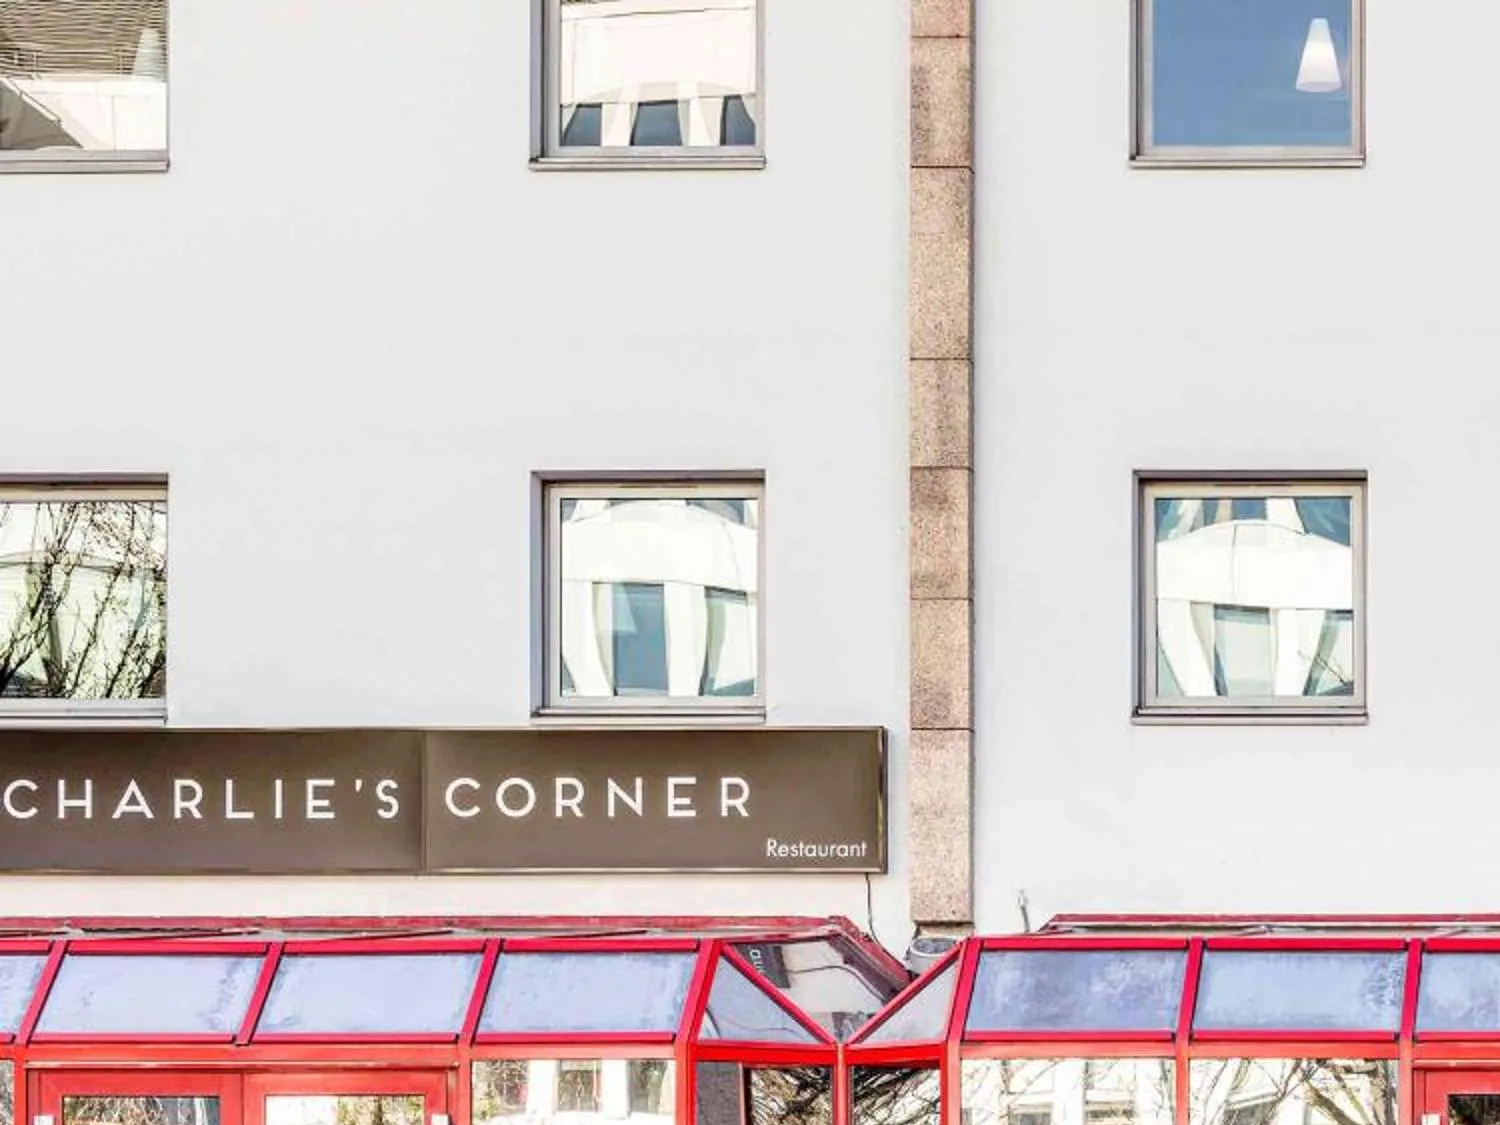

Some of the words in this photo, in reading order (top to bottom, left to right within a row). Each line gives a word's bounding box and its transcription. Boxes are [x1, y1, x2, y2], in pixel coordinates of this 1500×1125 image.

[2, 776, 400, 820] CHARLIE'S
[443, 775, 752, 819] CORNER
[766, 837, 867, 858] Restaurant
